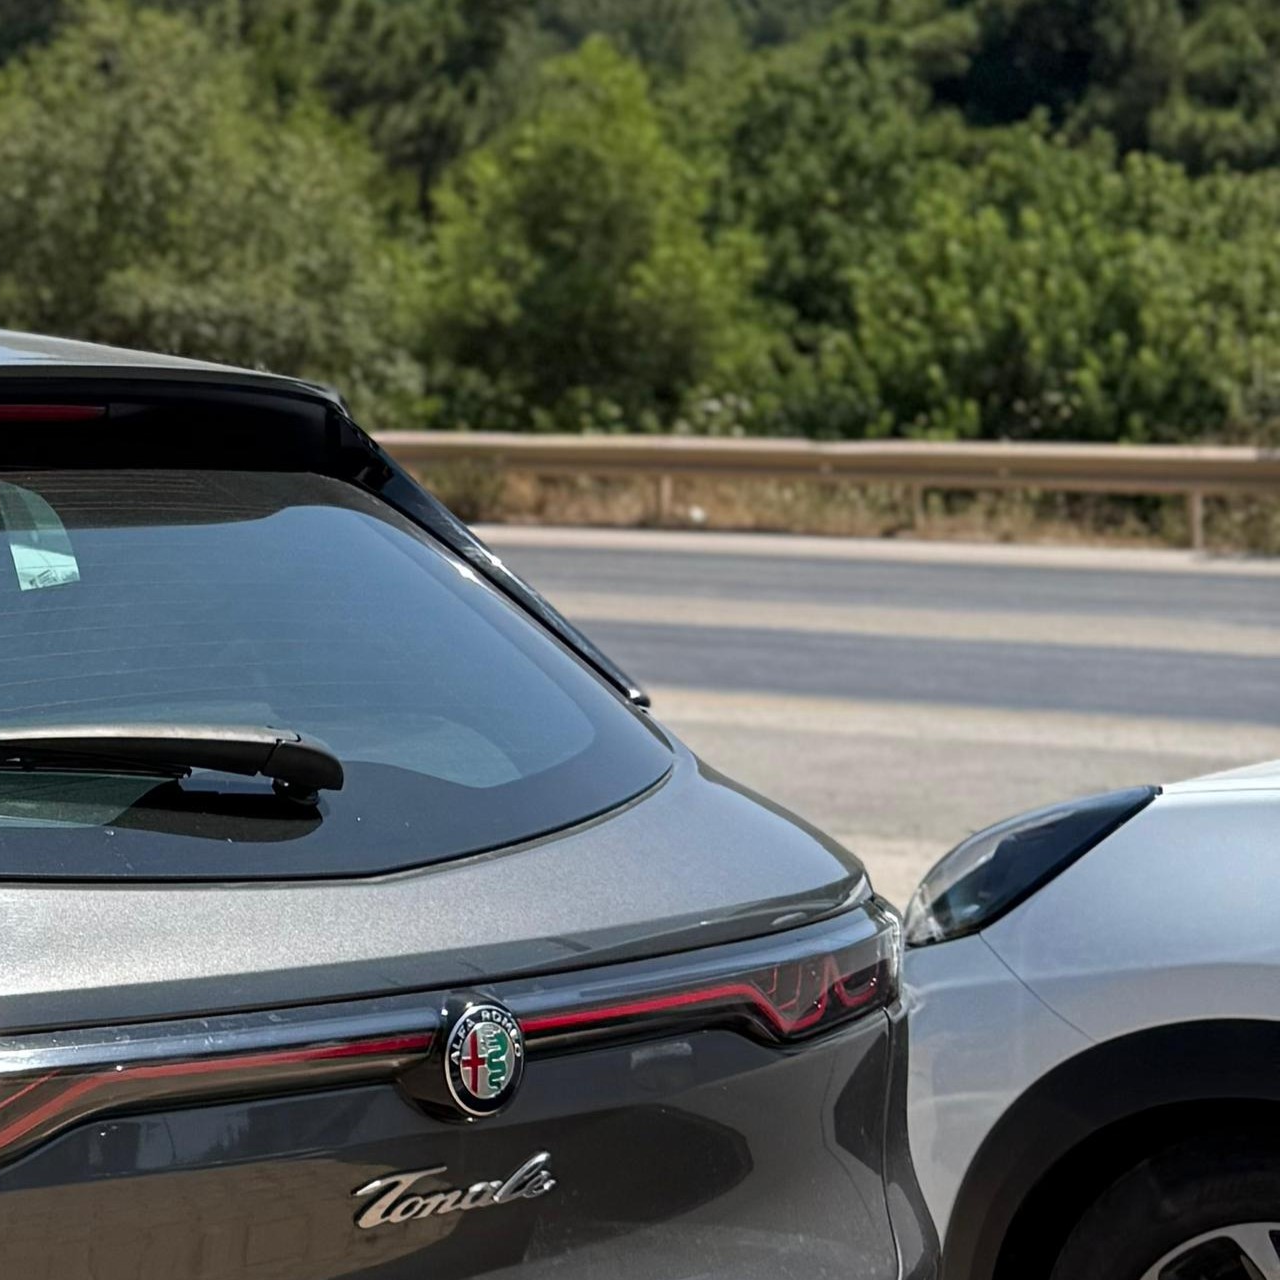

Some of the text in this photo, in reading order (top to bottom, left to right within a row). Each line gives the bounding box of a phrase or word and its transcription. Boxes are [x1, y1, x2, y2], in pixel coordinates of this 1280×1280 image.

[450, 1010, 521, 1065] ALFA ROMEO
[351, 1151, 556, 1229] Tonale
